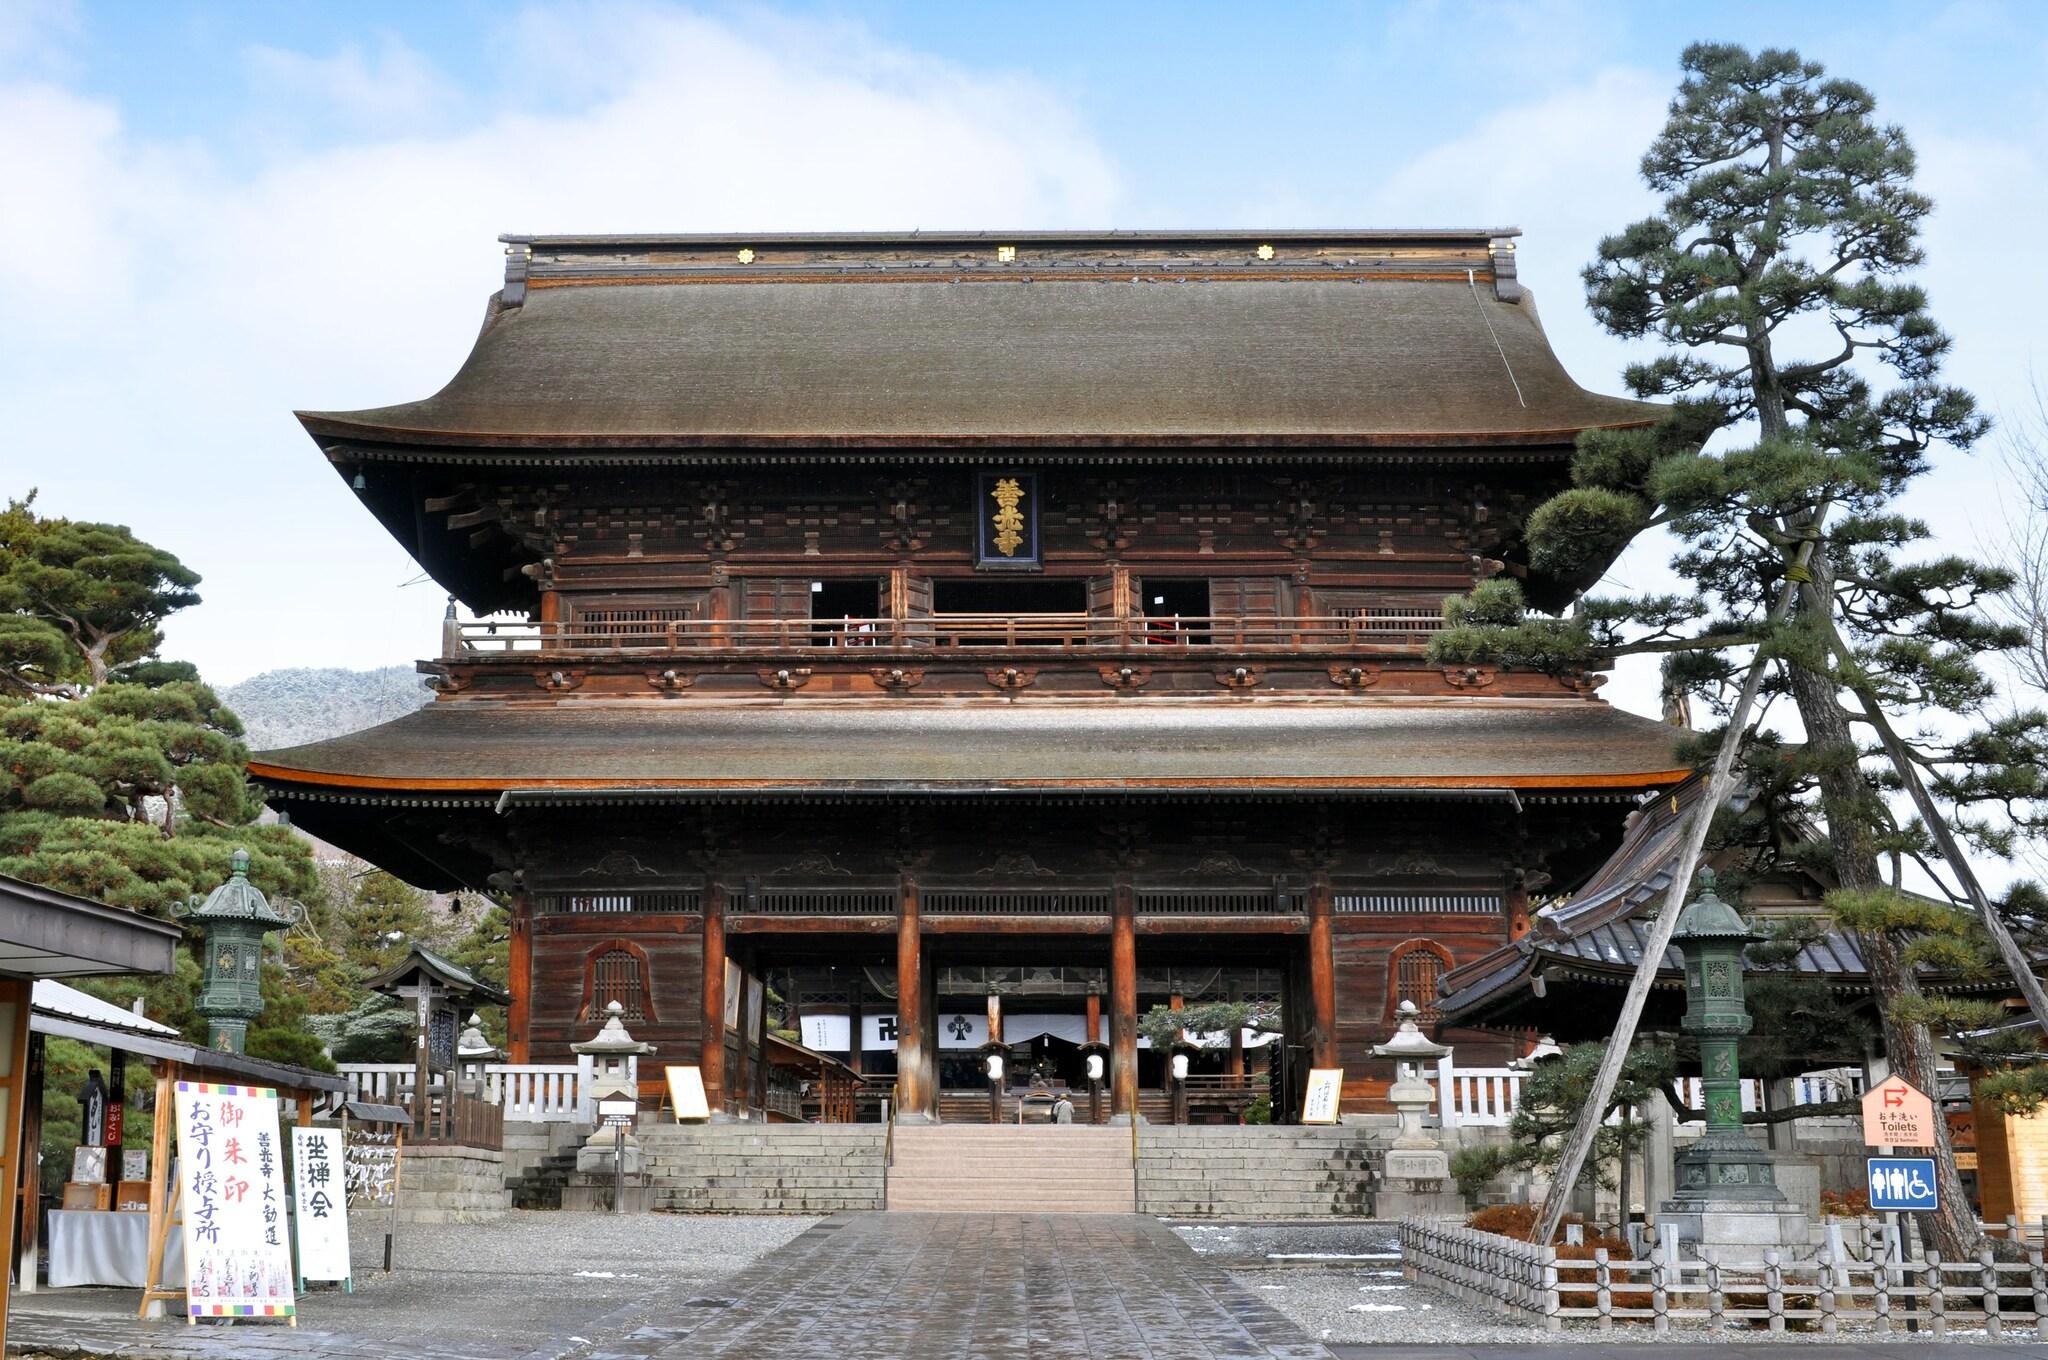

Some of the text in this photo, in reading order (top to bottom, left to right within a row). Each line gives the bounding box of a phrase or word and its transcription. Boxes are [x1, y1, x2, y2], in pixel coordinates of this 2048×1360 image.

[220, 1100, 250, 1203] 御朱印
[1879, 1112, 1918, 1121] お手洗い
[1880, 1122, 1918, 1131] Toilets
[190, 1100, 221, 1245] お守り授与所
[306, 1134, 333, 1218] 坐禅会
